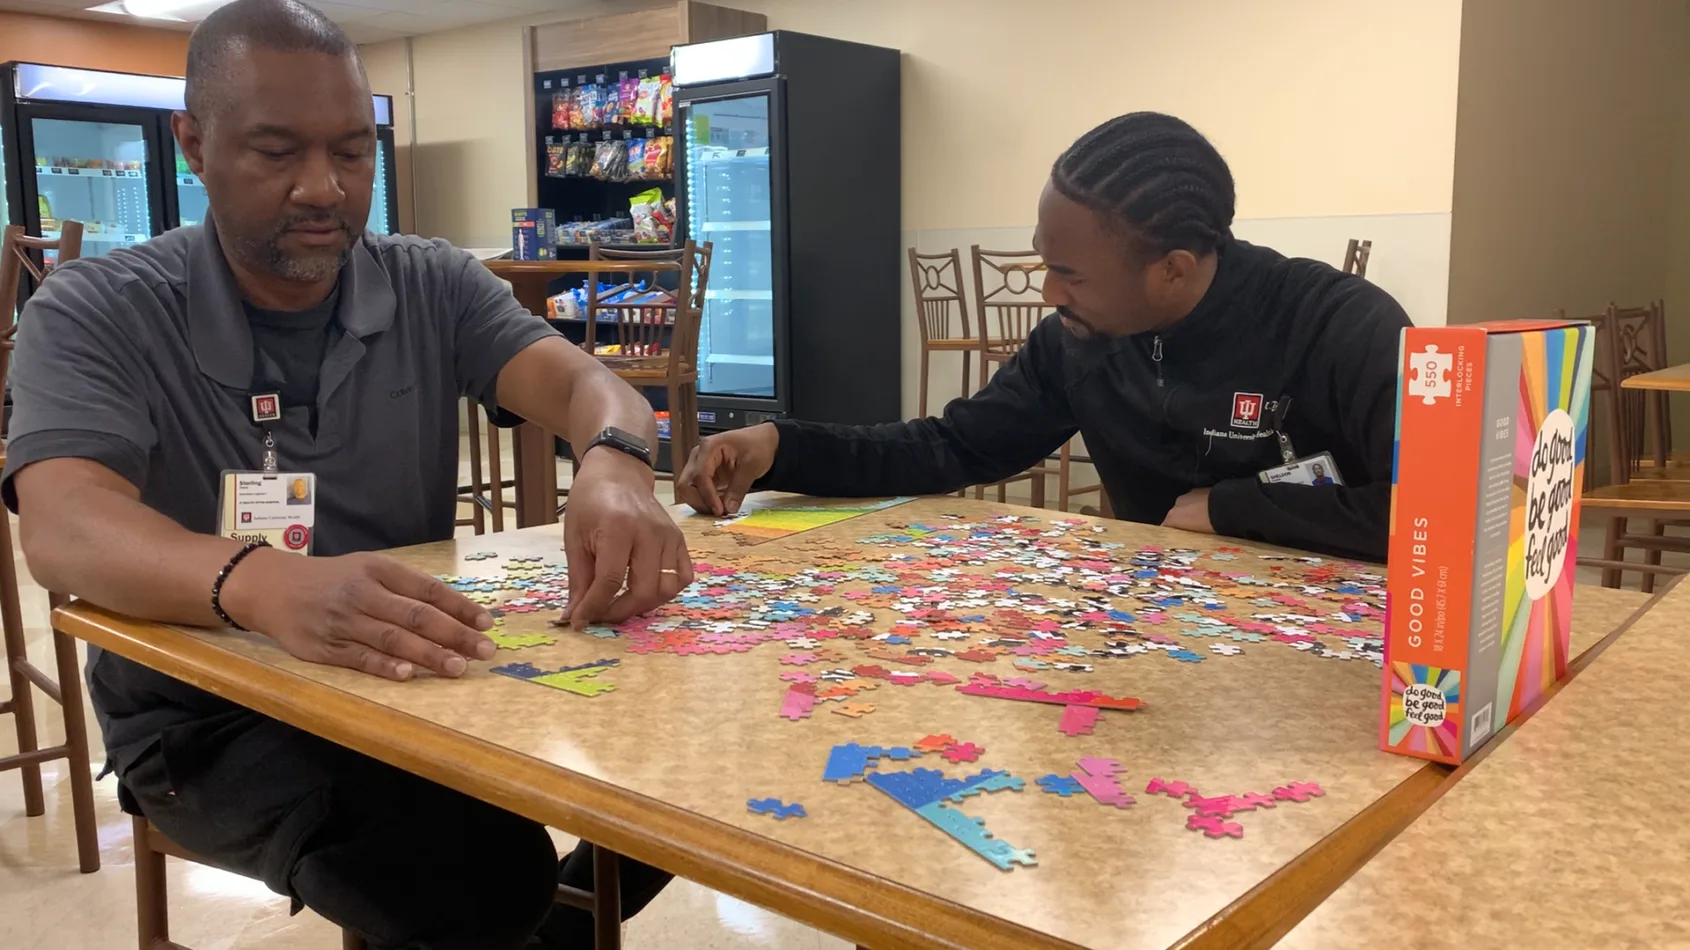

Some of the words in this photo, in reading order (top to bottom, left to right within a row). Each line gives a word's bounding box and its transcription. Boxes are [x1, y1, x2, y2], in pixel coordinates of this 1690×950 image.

[1425, 361, 1437, 388] 550
[1455, 345, 1465, 407] INTERLOCKING
[1465, 362, 1473, 391] PIECES
[1203, 428, 1227, 437] Indiana
[1532, 430, 1548, 477] do
[1547, 427, 1573, 484] good
[1528, 483, 1546, 531] be
[1547, 461, 1572, 532] good
[230, 533, 268, 543] Supply
[1412, 517, 1428, 577] VIBES
[1526, 533, 1547, 580] feel
[1544, 511, 1569, 584] good
[1408, 587, 1424, 648] GOOD
[1405, 686, 1419, 696] do
[1420, 689, 1442, 700] good
[1405, 696, 1420, 709] be
[1422, 701, 1444, 712] good
[1405, 707, 1423, 721] feel
[1423, 711, 1443, 724] good
